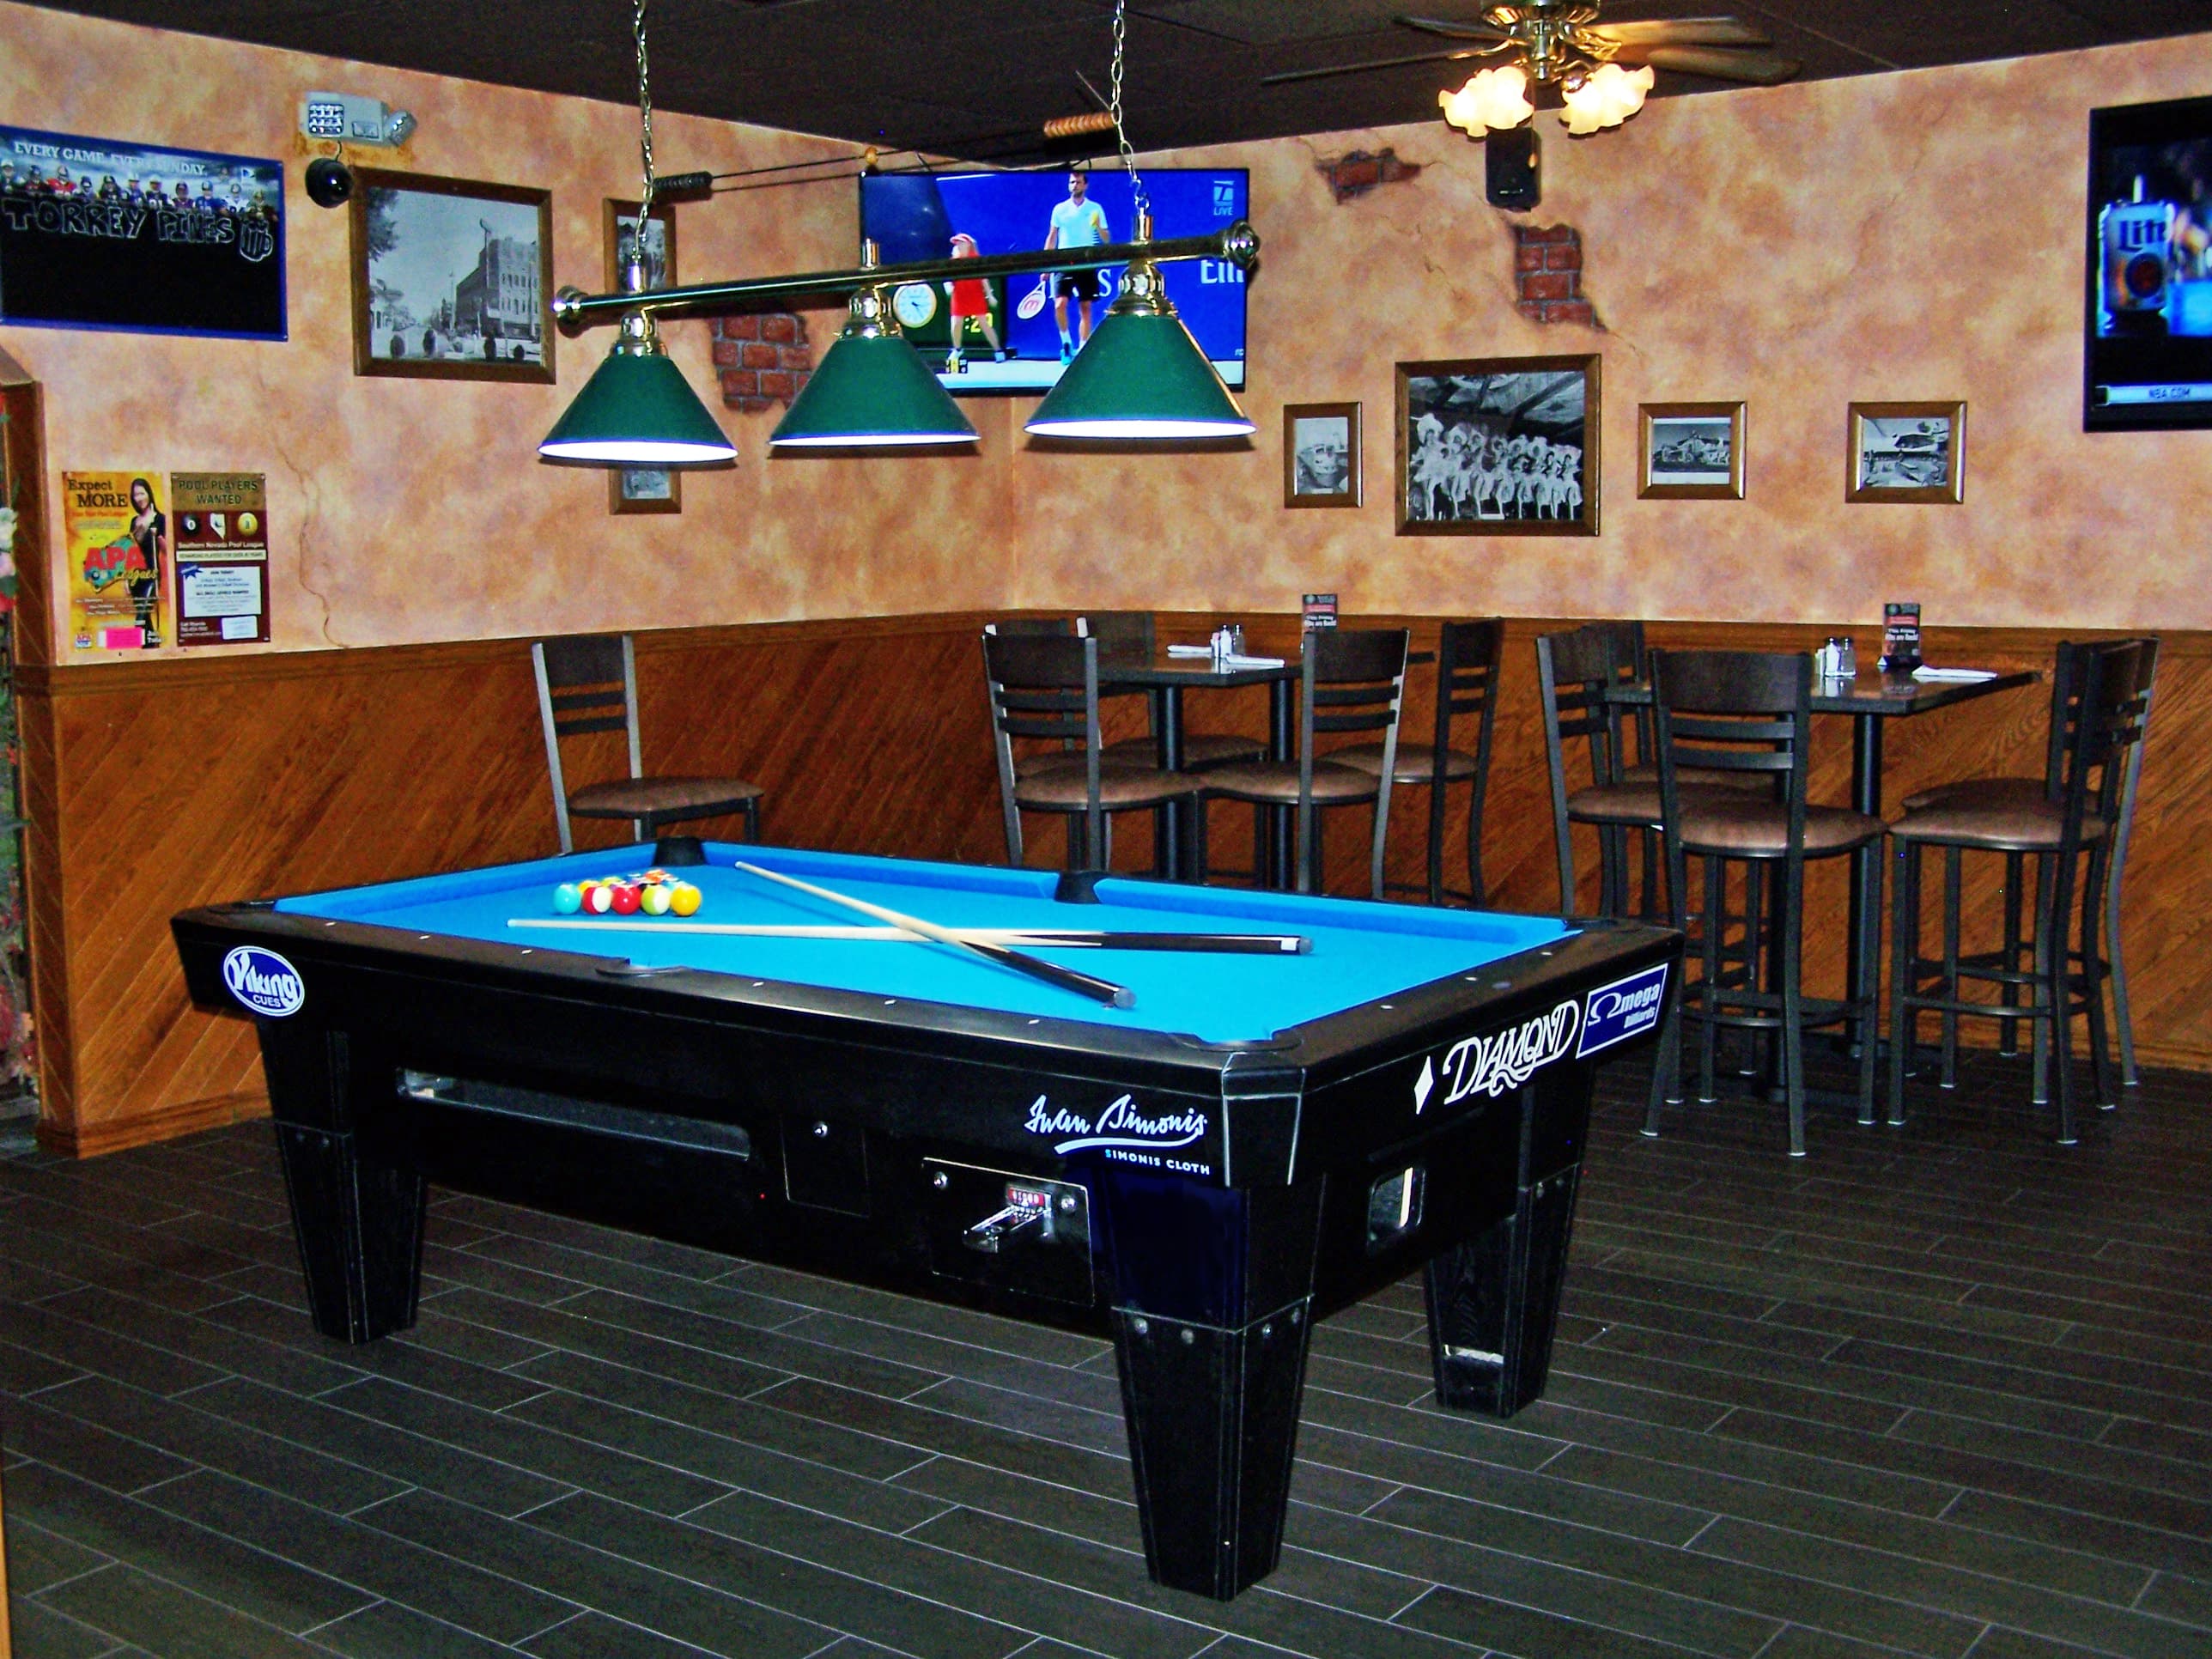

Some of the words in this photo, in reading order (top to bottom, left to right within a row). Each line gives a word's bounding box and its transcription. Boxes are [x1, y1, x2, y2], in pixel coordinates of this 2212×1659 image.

[14, 141, 60, 159] EVERY
[110, 153, 155, 170] EVER
[1, 197, 148, 239] TORREY
[155, 209, 236, 244] PINES
[1212, 206, 1234, 216] LIVE
[68, 478, 113, 493] Expect
[178, 480, 208, 490] POOL
[211, 480, 258, 491] PLAYERS
[76, 494, 129, 507] MORE
[197, 494, 243, 505] WANTED
[83, 546, 148, 571] APA
[228, 951, 300, 1008] Viking
[252, 994, 282, 1008] CUES
[1442, 1000, 1580, 1106] DIAMOND
[1096, 1093, 1208, 1136] Simonis
[1104, 1148, 1162, 1168] SIMONIS
[1166, 1156, 1211, 1176] CLOTH
